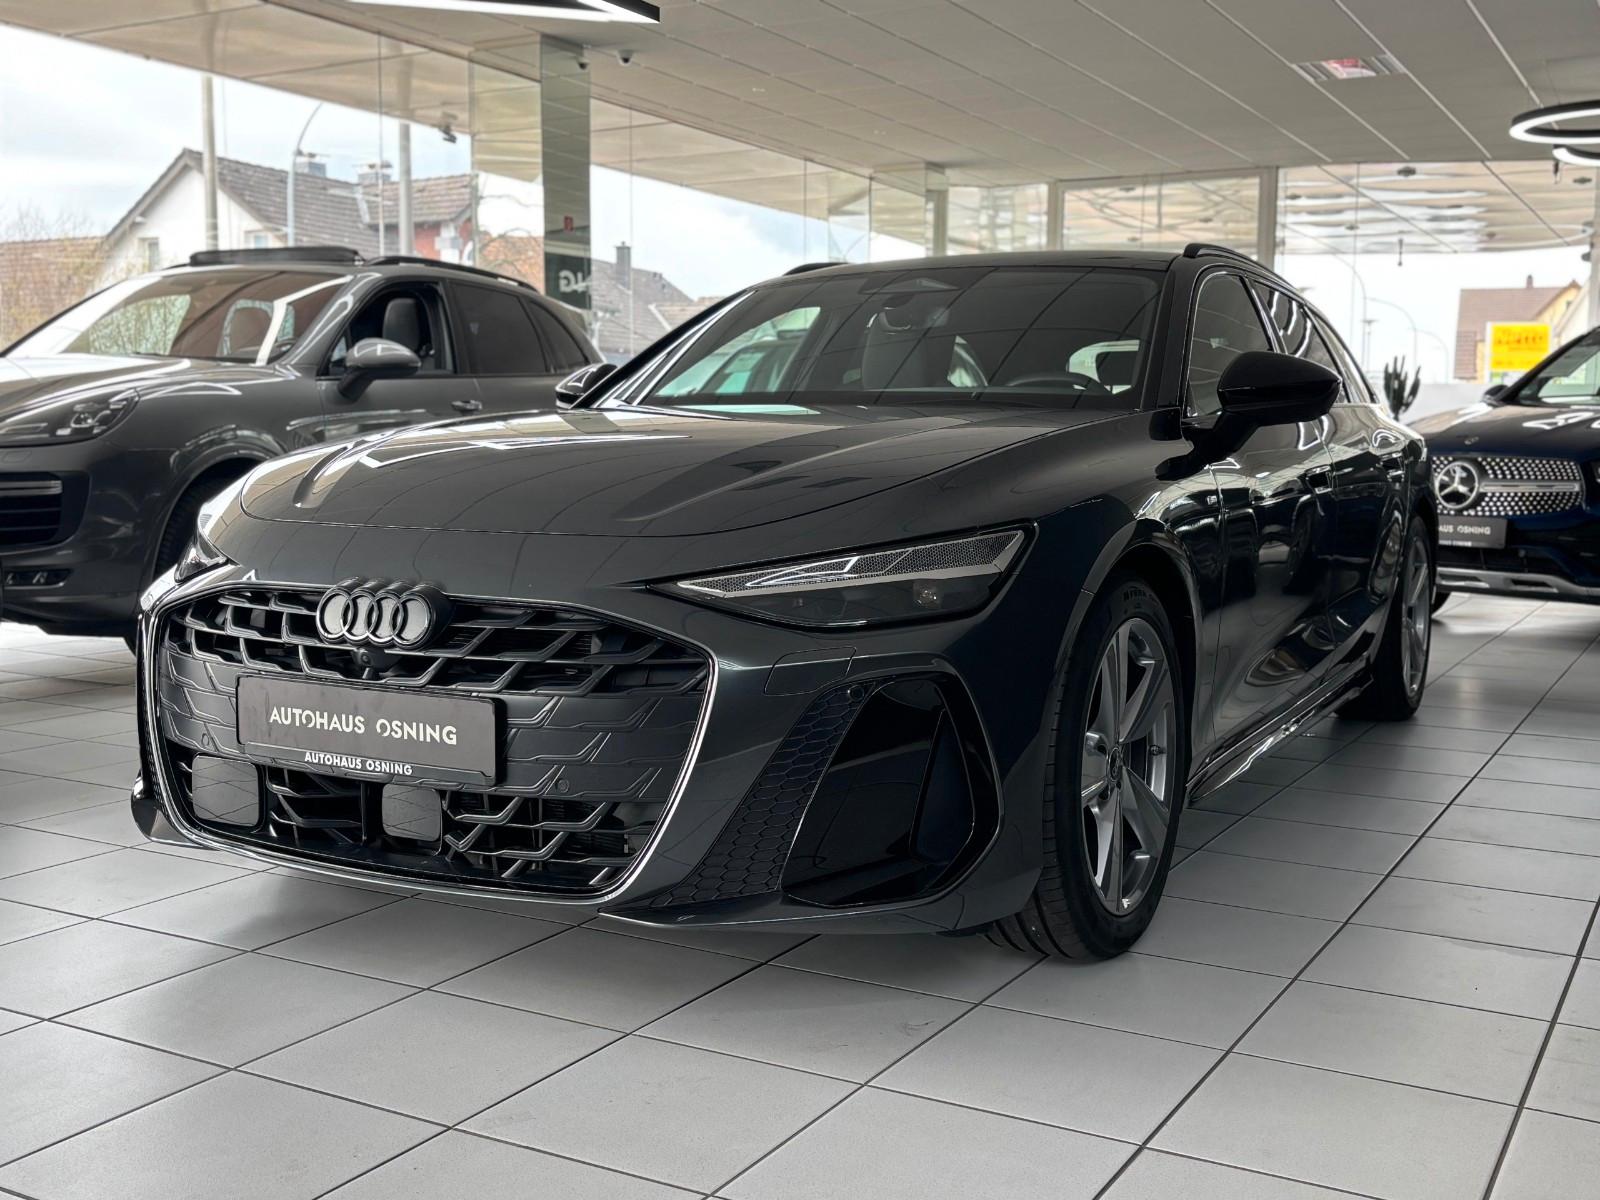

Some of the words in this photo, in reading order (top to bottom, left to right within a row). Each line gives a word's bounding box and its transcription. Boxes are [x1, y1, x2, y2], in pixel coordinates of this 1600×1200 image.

[1457, 524, 1491, 535] OSNING
[269, 706, 366, 734] AUTOHAUS
[376, 718, 457, 746] OSNING
[304, 751, 362, 769] AUTOHAUS
[366, 760, 413, 776] OSNING
